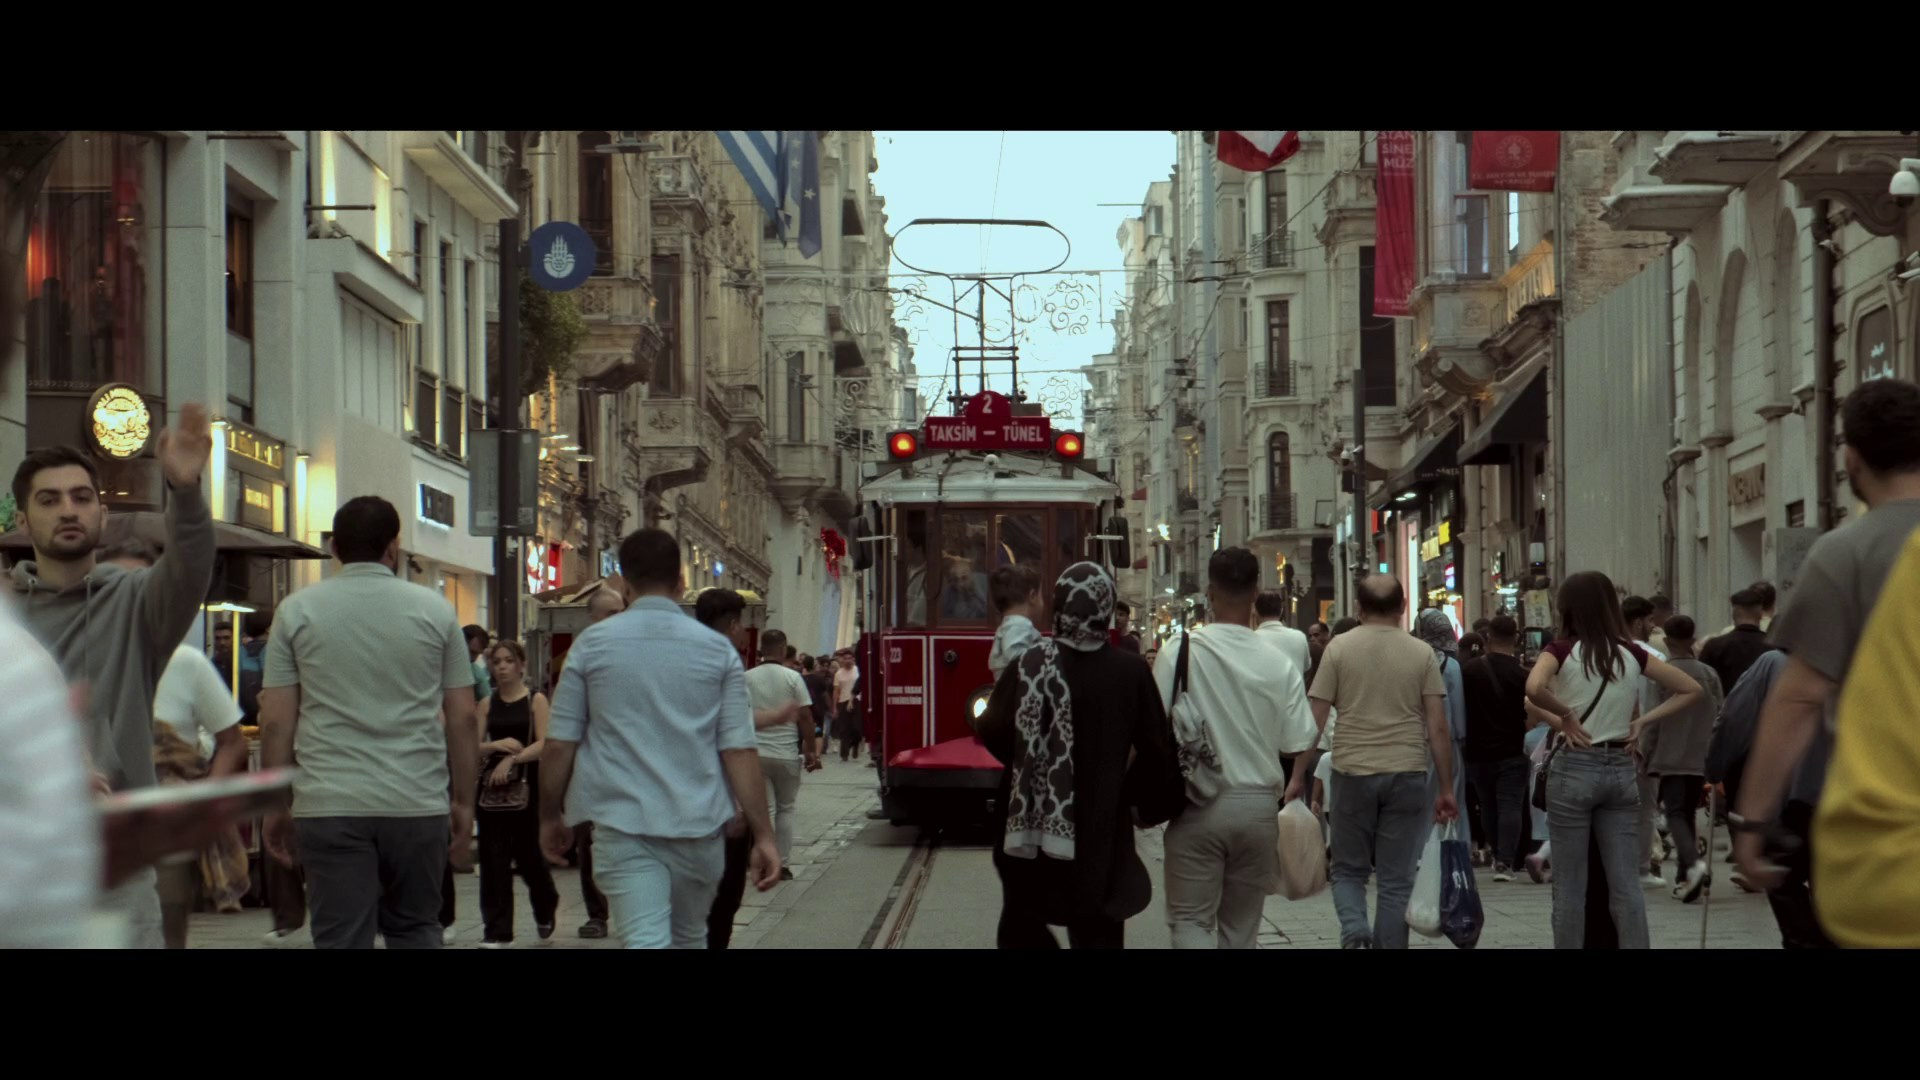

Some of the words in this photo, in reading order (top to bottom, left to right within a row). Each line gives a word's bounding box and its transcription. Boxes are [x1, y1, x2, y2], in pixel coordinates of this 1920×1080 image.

[982, 393, 993, 414] 2
[929, 421, 977, 442] TAKSİM
[1002, 421, 1044, 442] TÜNEL
